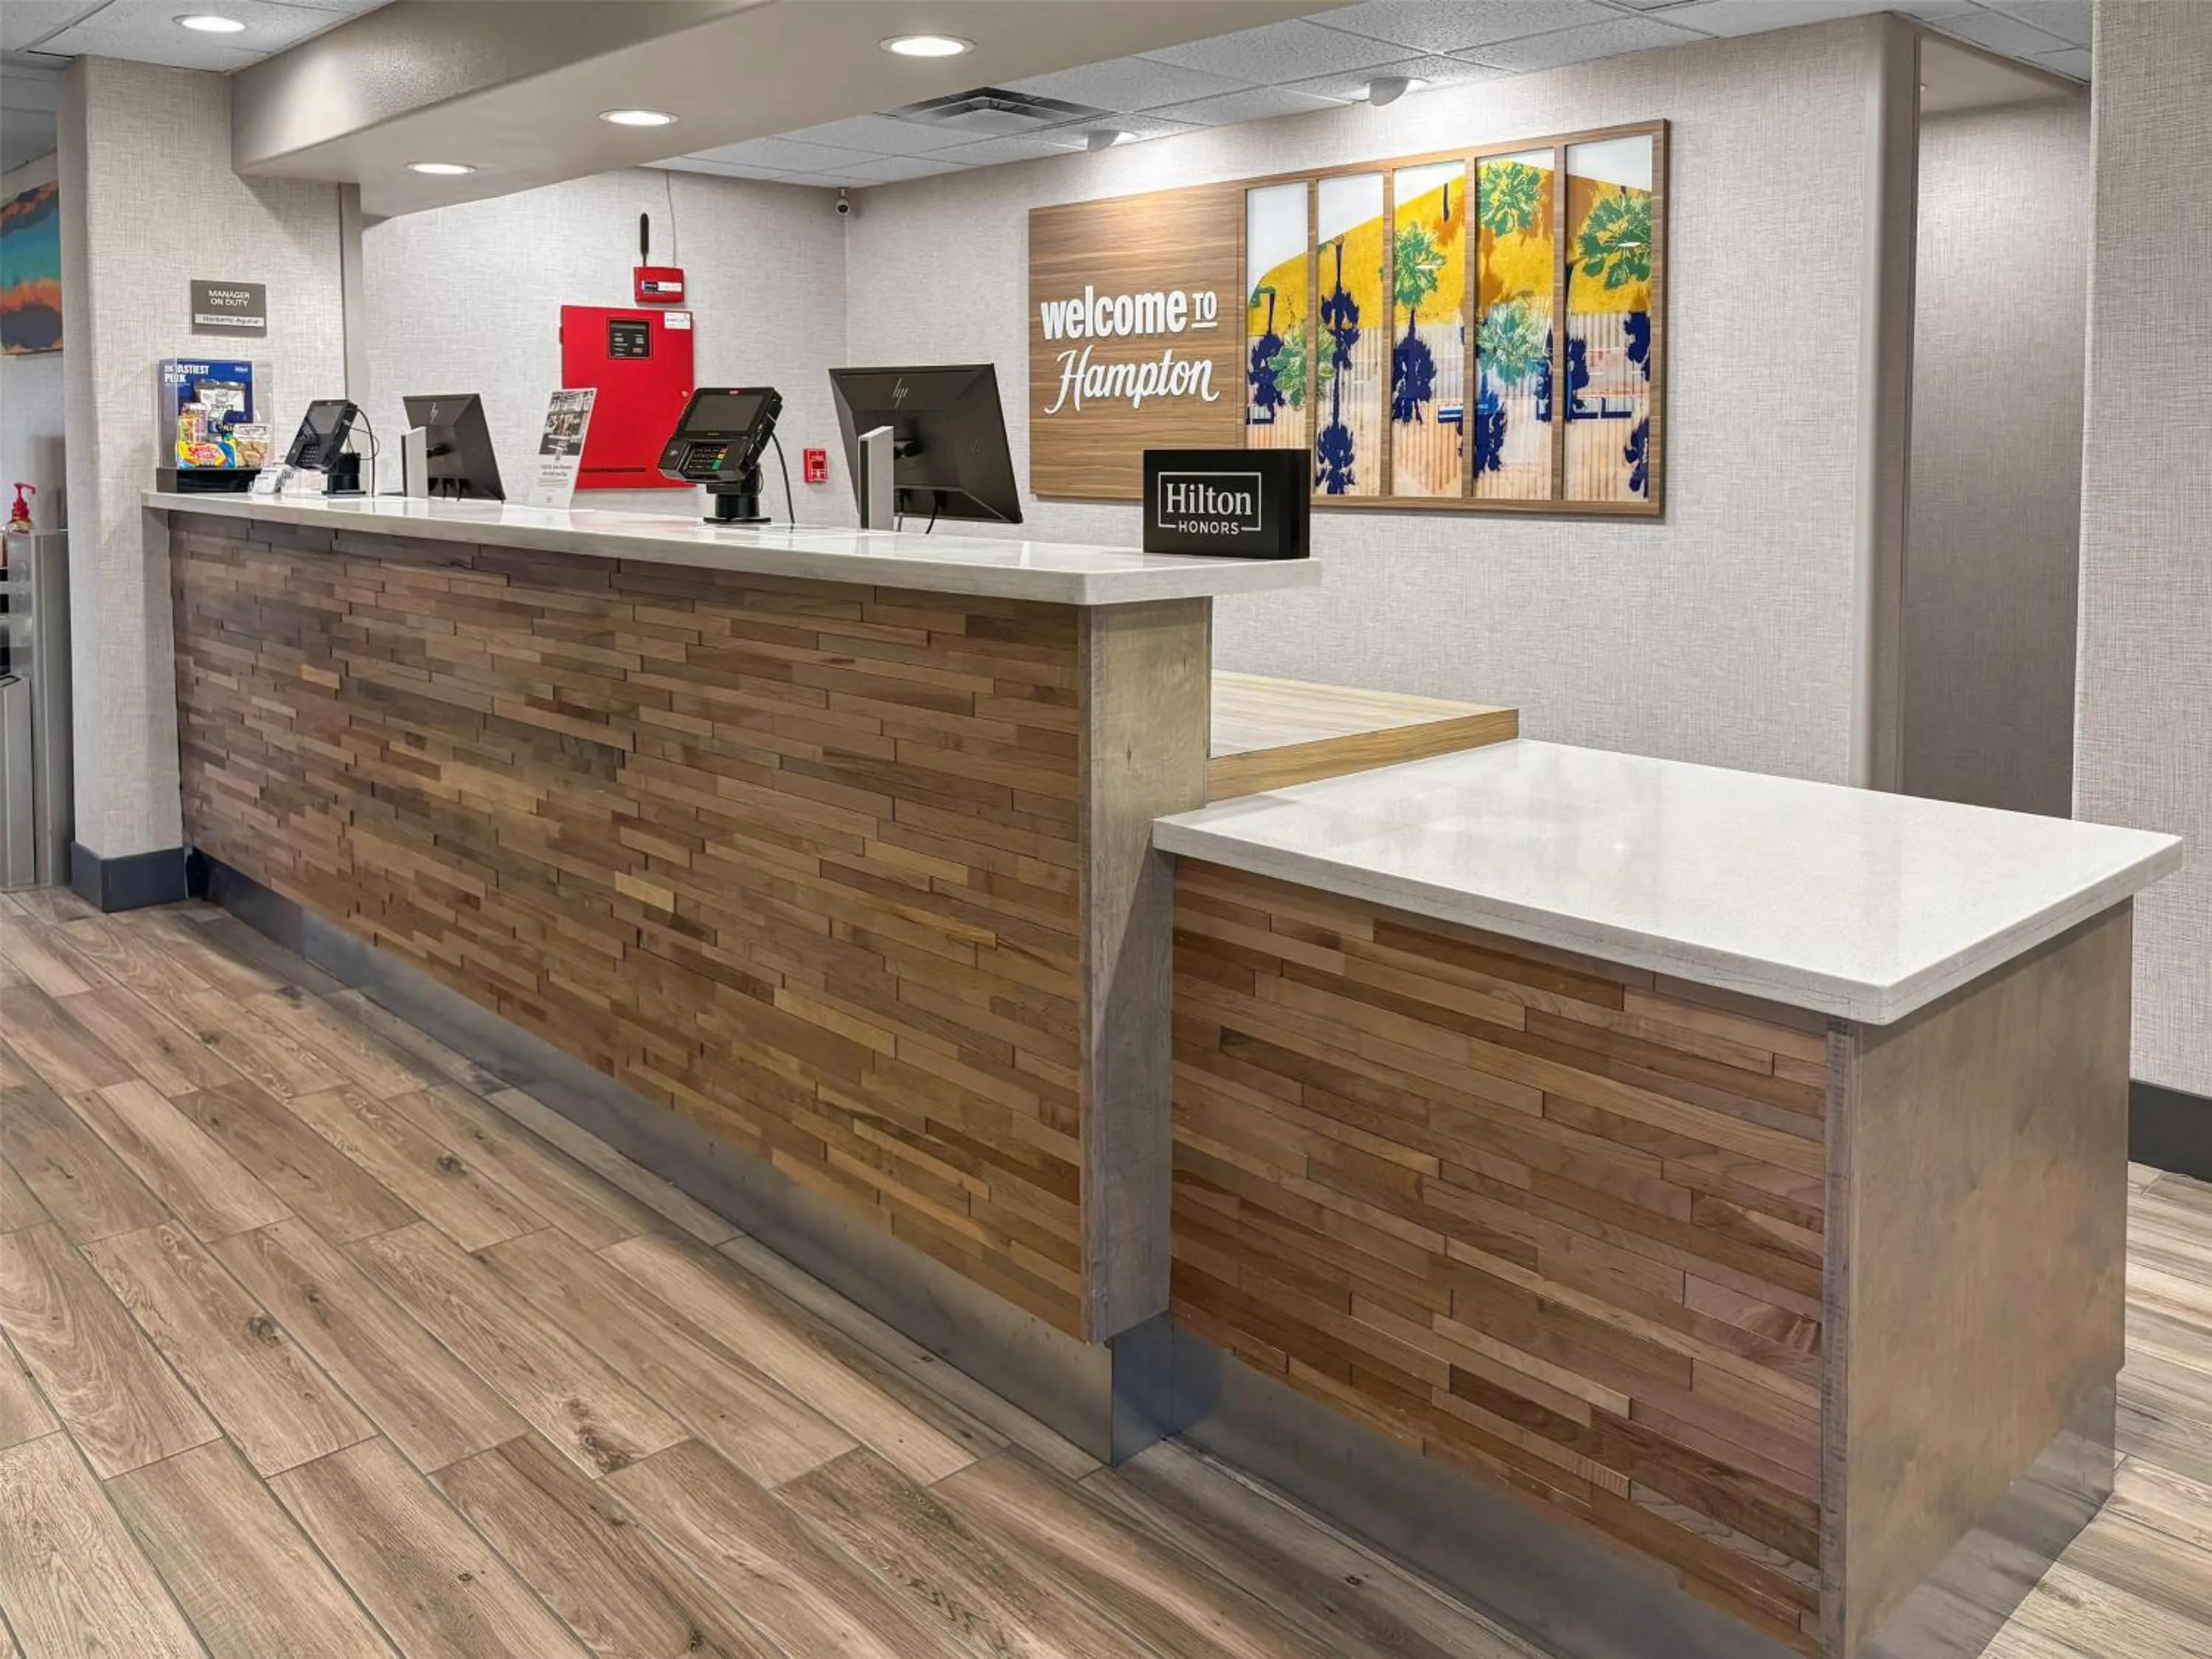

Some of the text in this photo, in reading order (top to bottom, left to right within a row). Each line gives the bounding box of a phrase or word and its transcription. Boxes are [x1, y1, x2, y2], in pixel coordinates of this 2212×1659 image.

[209, 290, 250, 299] MANAGER
[210, 298, 248, 307] ON DUTY
[1040, 285, 1218, 340] welcome TO
[1044, 344, 1220, 414] Hampton
[1166, 483, 1253, 515] Hilton
[1178, 520, 1239, 535] HONORS
